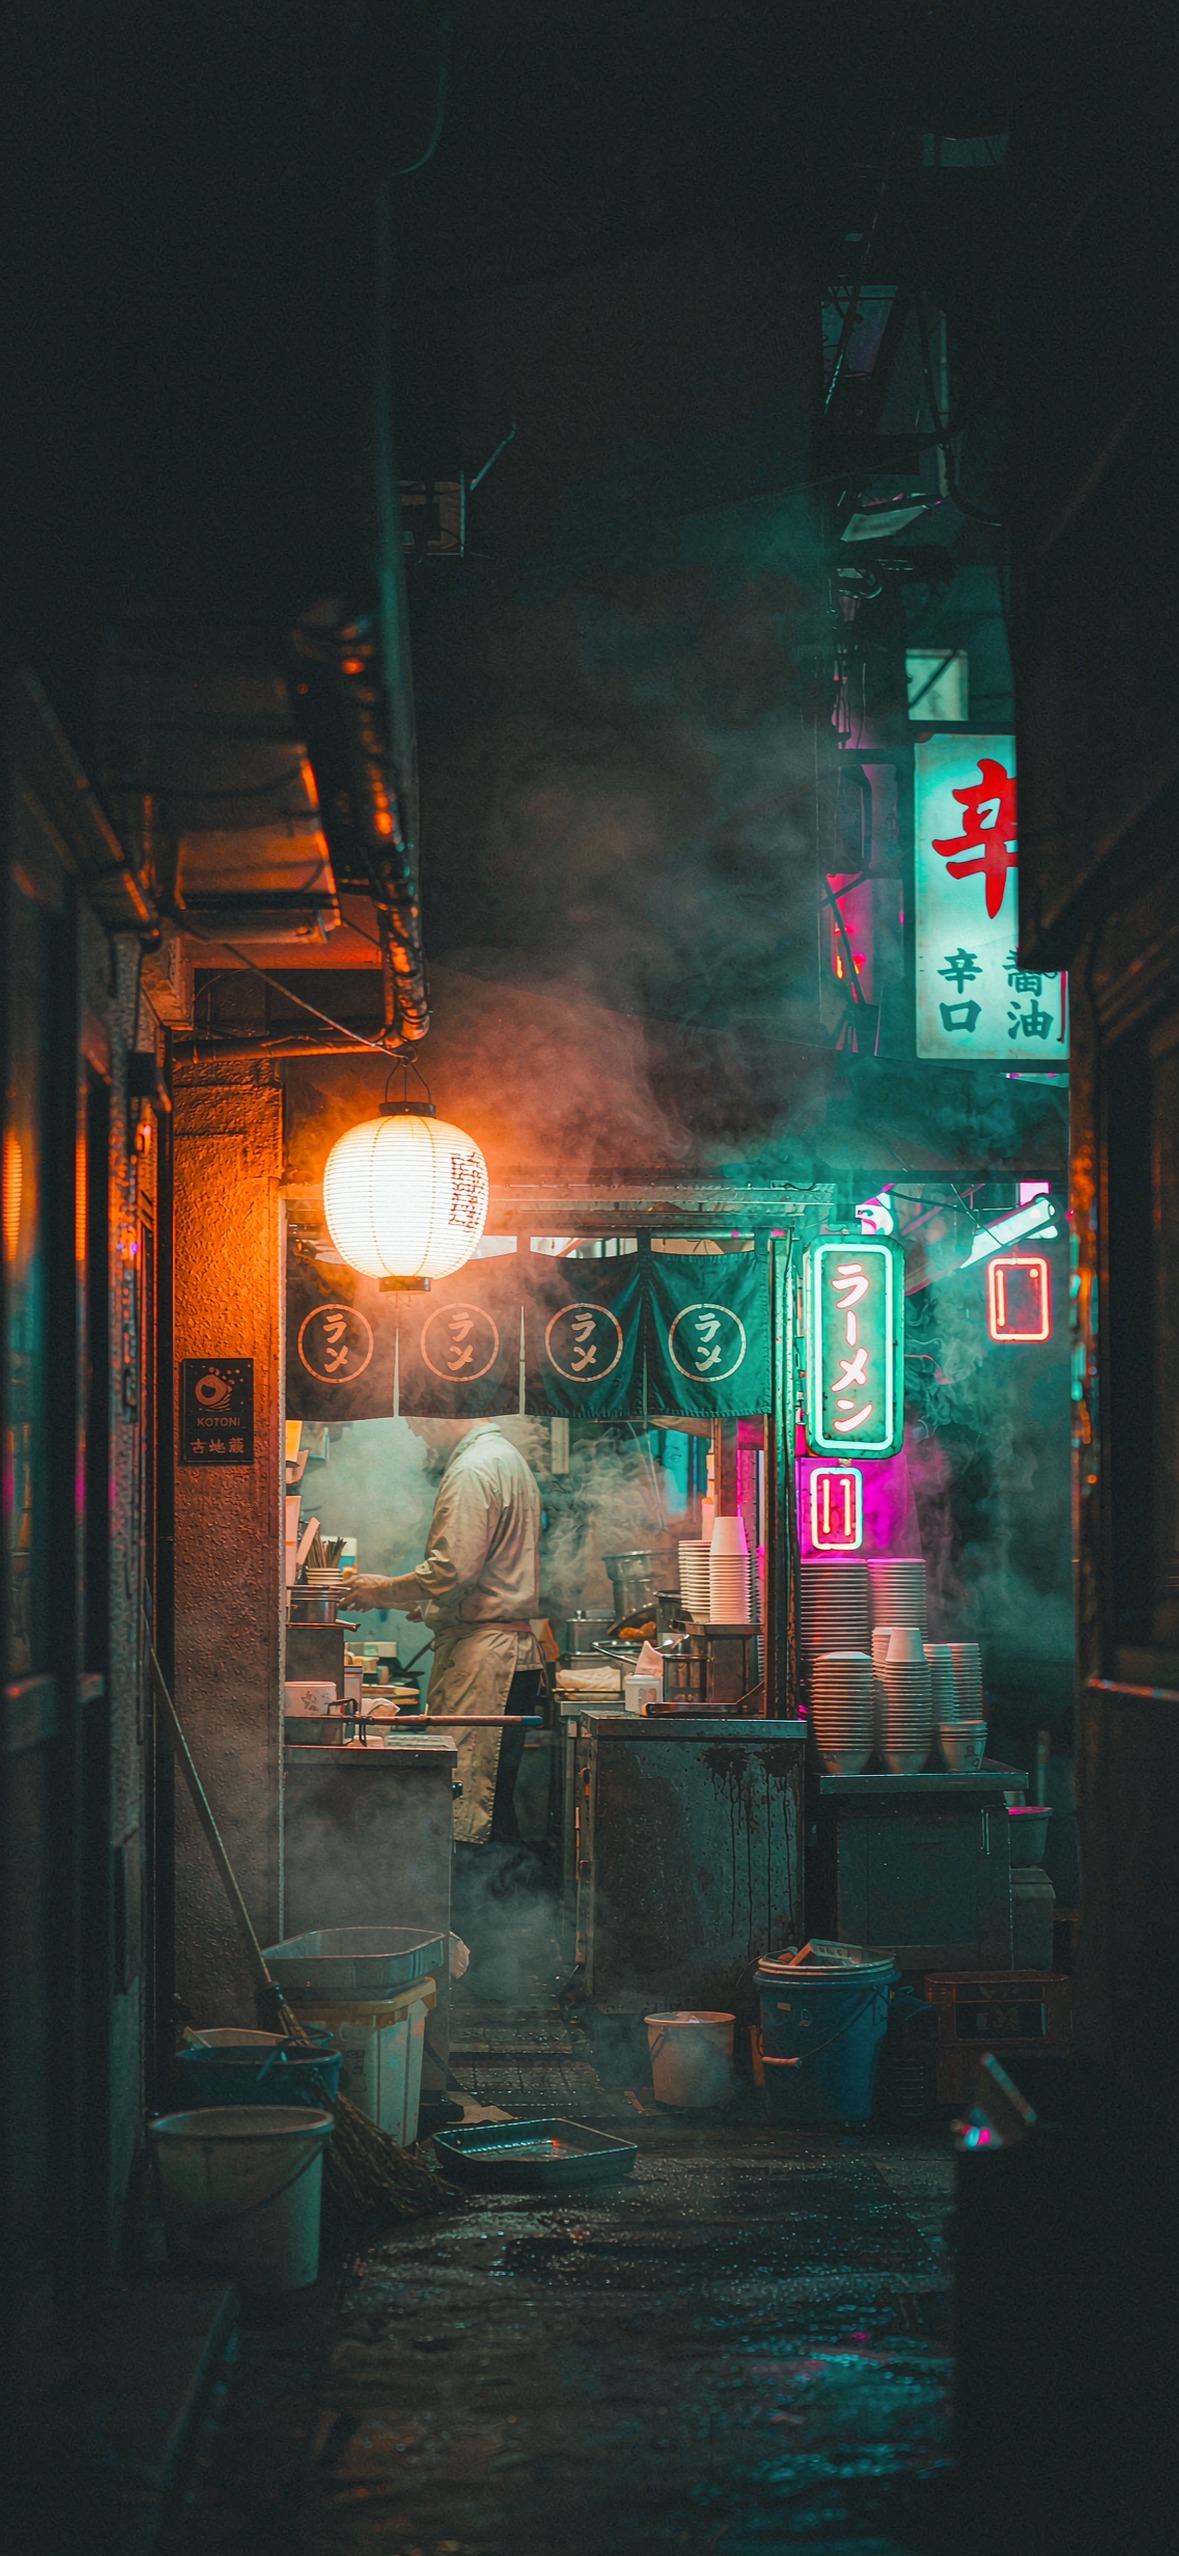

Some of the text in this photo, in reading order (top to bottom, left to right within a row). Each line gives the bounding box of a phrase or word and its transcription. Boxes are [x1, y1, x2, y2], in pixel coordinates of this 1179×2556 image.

[937, 947, 983, 1034] 辛口
[830, 1262, 873, 1433] ラーメン
[197, 1417, 240, 1427] KOTONI
